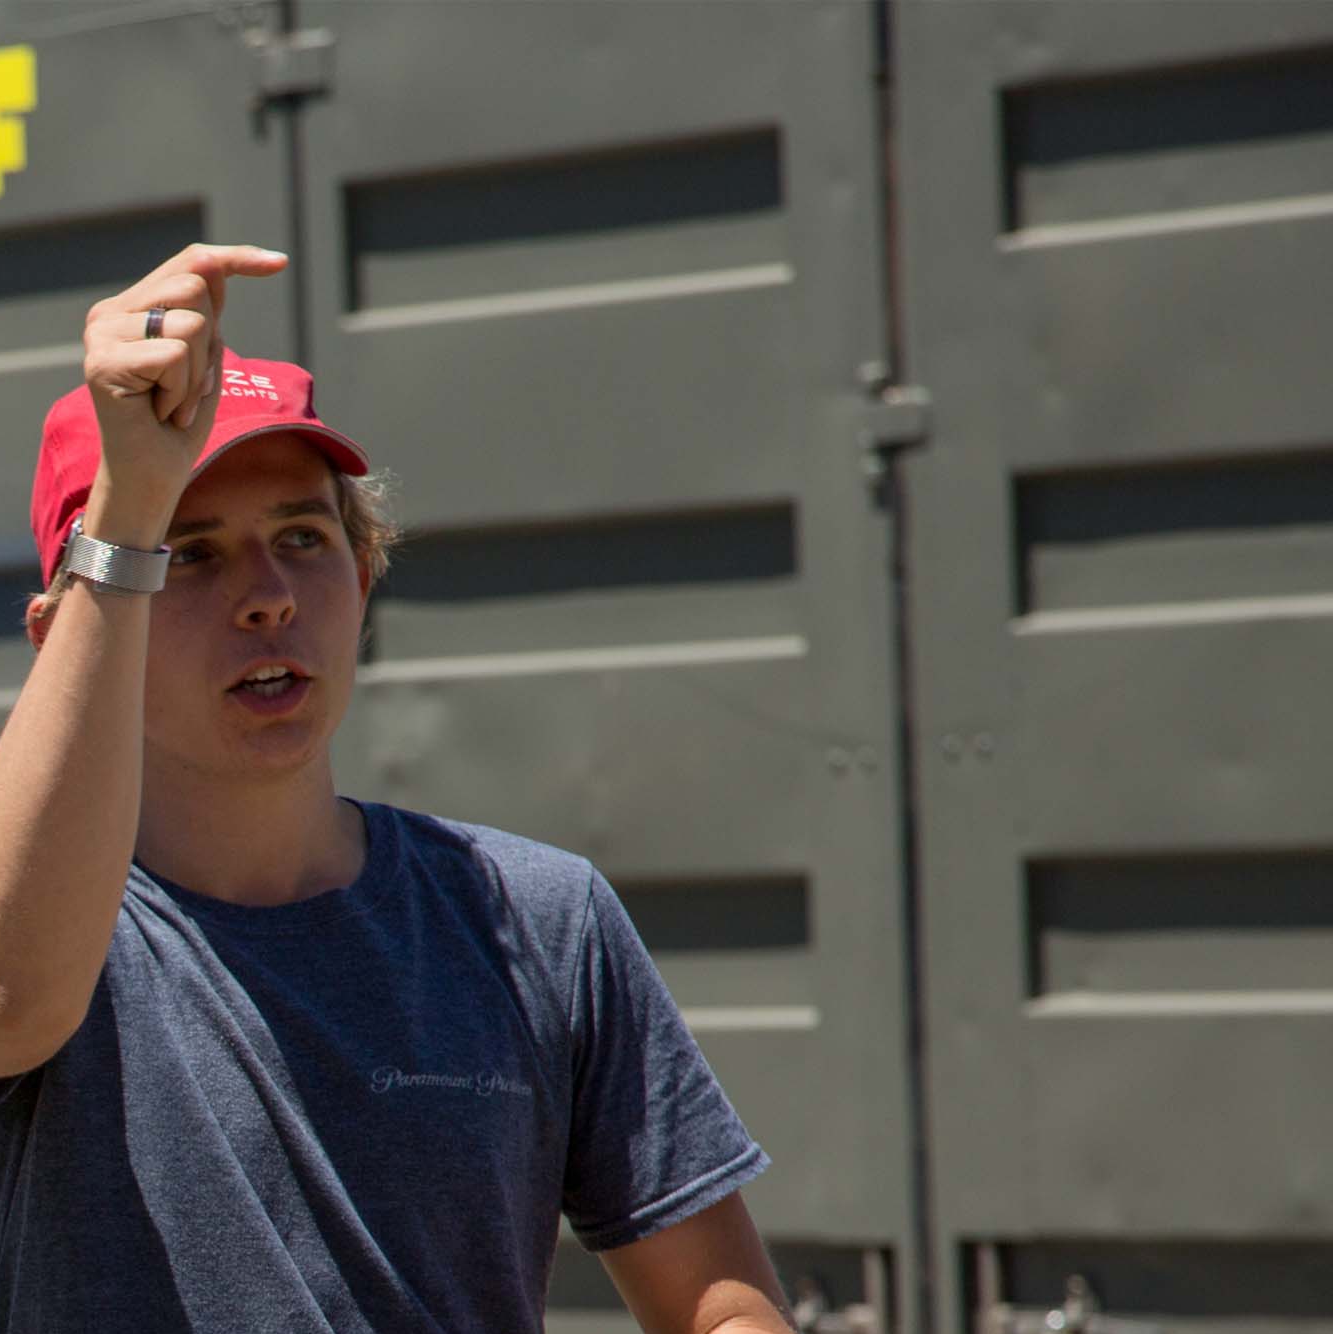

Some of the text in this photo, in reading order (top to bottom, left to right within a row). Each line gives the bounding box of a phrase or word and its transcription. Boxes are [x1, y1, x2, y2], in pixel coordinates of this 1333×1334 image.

[223, 369, 276, 390] ZE
[221, 387, 279, 401] ACHTS
[370, 1066, 473, 1093] Paramount
